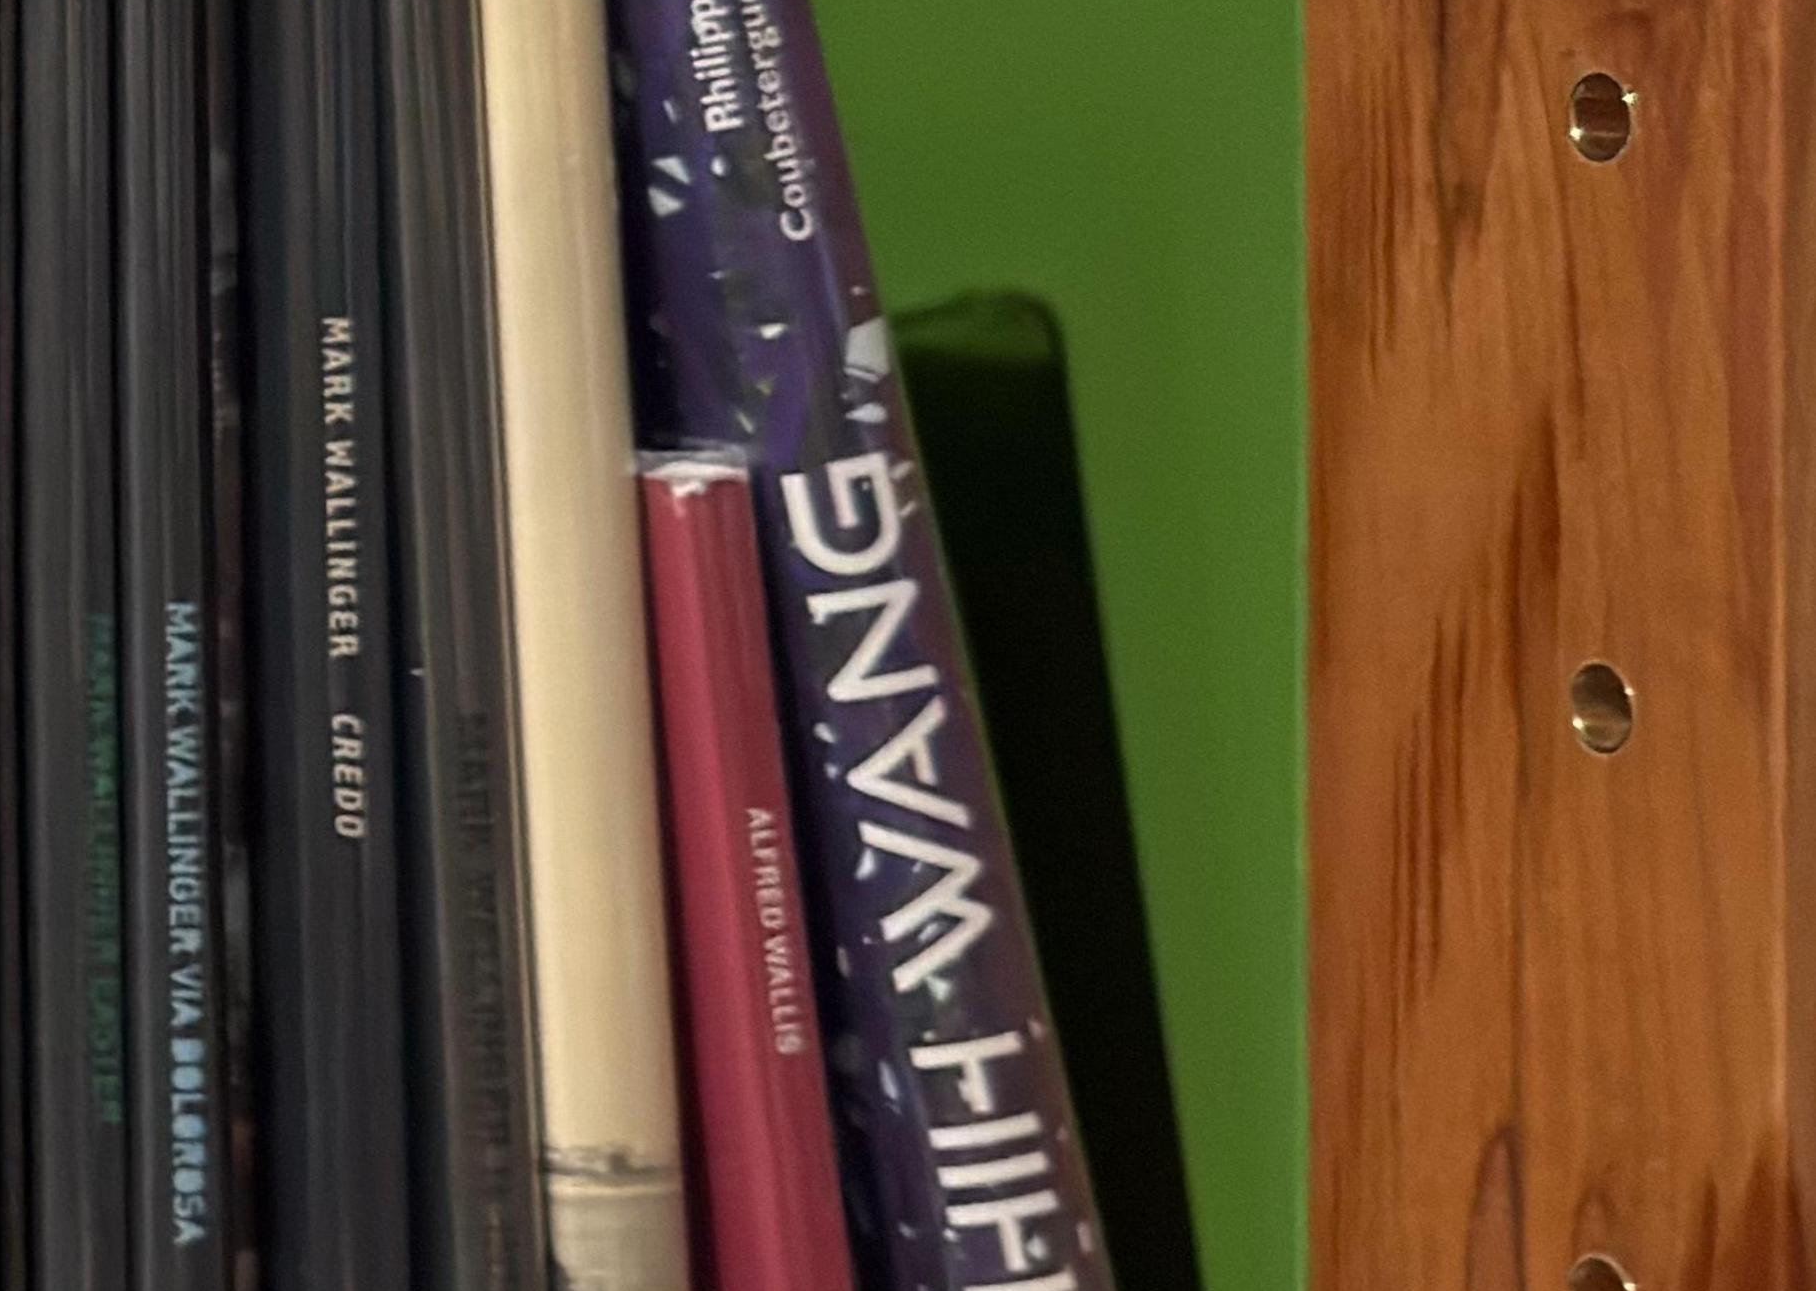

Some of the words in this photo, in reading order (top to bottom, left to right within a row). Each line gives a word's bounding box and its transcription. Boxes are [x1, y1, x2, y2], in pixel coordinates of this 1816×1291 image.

[320, 315, 356, 424] MARK
[324, 440, 361, 659] WALLINGER
[163, 602, 204, 712] MARK
[166, 716, 206, 955] WALLINGER
[331, 711, 365, 840] CREDO
[745, 806, 785, 929] ALFRED
[169, 965, 206, 1030] VIA
[764, 929, 806, 1059] WALLIS
